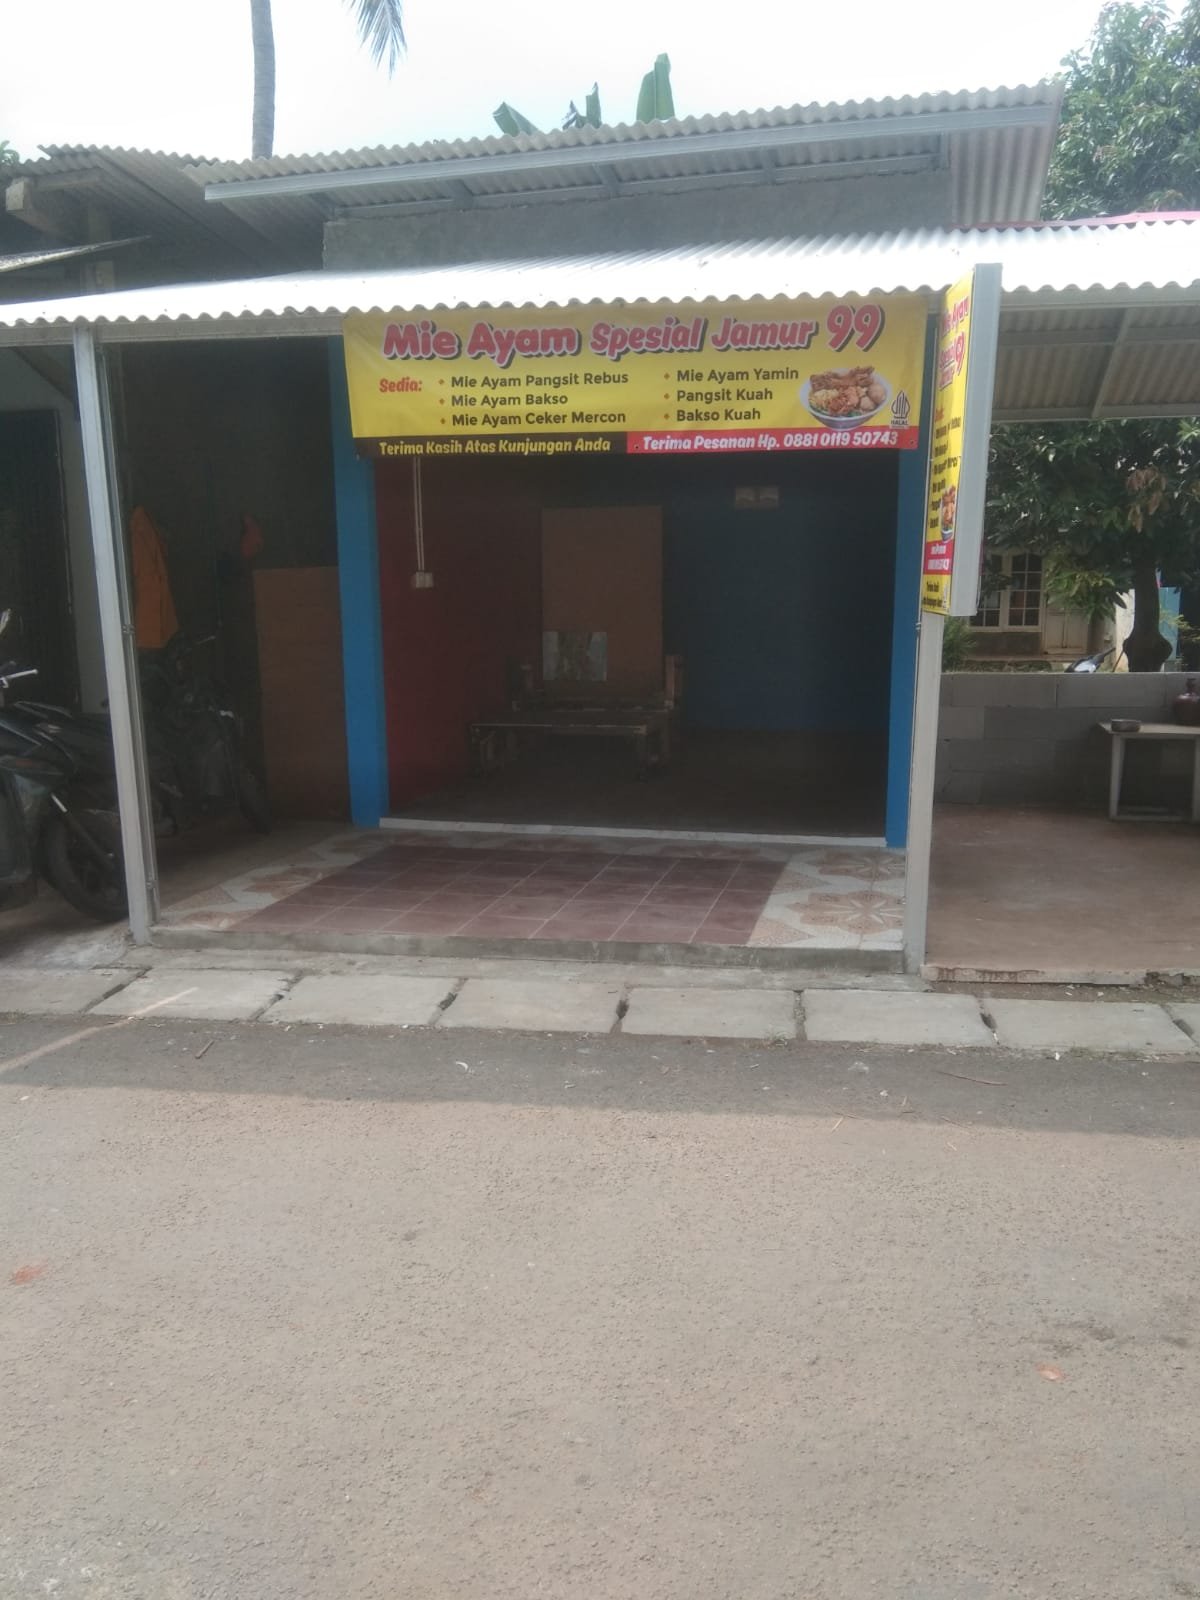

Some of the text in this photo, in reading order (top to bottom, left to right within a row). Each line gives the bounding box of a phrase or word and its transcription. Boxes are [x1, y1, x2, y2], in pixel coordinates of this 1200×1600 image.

[382, 304, 883, 367] Mie Ayam Spesial Jamur 99
[451, 372, 629, 390] Mie Ayam Pangsit Rebus
[676, 367, 799, 385] Mie Ayam Yamin
[379, 378, 423, 393] Sedia:
[451, 393, 568, 409] Mie Ayam Bakso
[676, 388, 774, 405] Pangsit Kuah
[452, 410, 626, 429] Mie Ayam Ceker Mercon
[676, 408, 761, 422] Bakso Kuah
[379, 437, 611, 456] Terima Kasih Atas Kunjungan Anda
[643, 431, 898, 451] Terima Pesanan Hp. 0881 0119 50743
